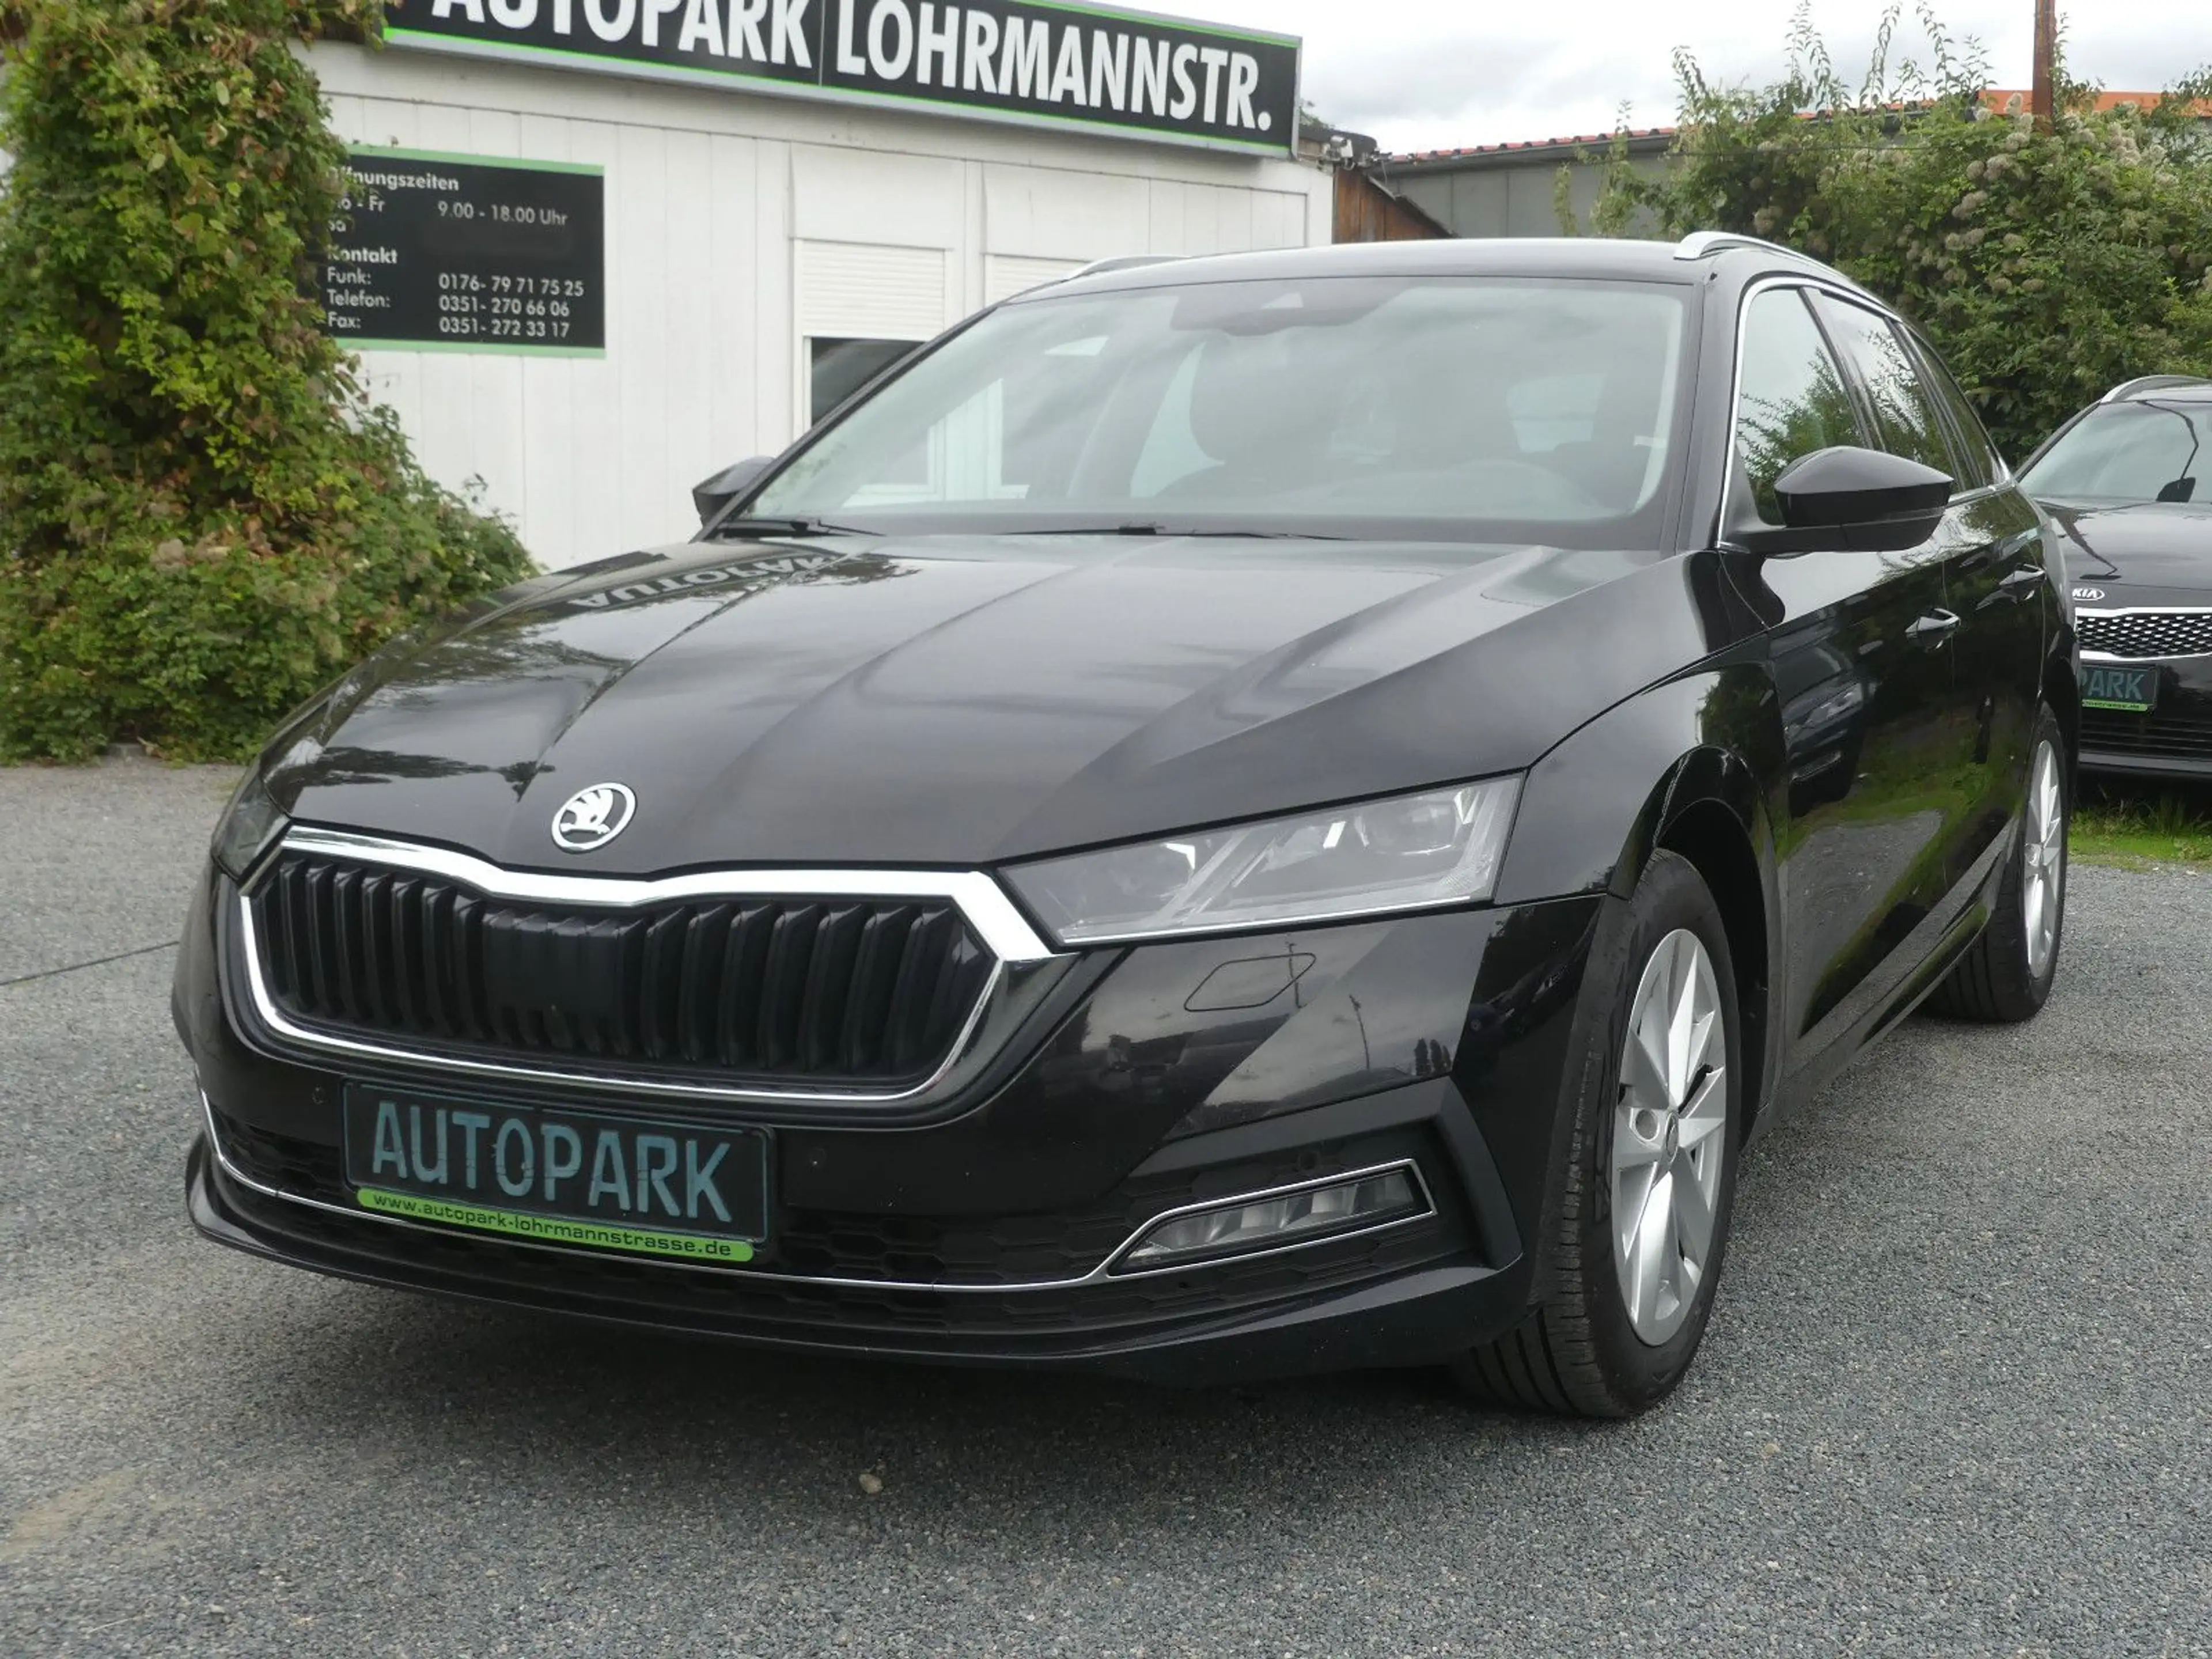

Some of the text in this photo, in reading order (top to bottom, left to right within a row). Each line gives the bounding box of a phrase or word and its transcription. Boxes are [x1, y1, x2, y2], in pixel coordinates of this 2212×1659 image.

[837, 0, 1271, 131] LOHRMANNSTR.
[369, 195, 386, 213] Fr
[438, 200, 475, 219] 9.00
[491, 204, 536, 224] 18.00
[540, 208, 568, 226] Uhr
[327, 266, 372, 285] Funk:
[491, 275, 512, 293] 79
[516, 277, 534, 293] 71
[540, 278, 560, 296] 75
[564, 280, 585, 297] 25
[327, 289, 392, 308] Telefon:
[491, 297, 522, 314] 270
[525, 300, 546, 316] 66
[550, 300, 570, 317] 06
[327, 310, 362, 329] Fax:
[491, 319, 521, 336] 272
[526, 320, 546, 337] 33
[551, 321, 570, 338] 17
[2072, 588, 2097, 599] KIA
[372, 1101, 732, 1222] AUTOPARK
[373, 1192, 732, 1257] www.autopark-lohrmannstrasse.de
